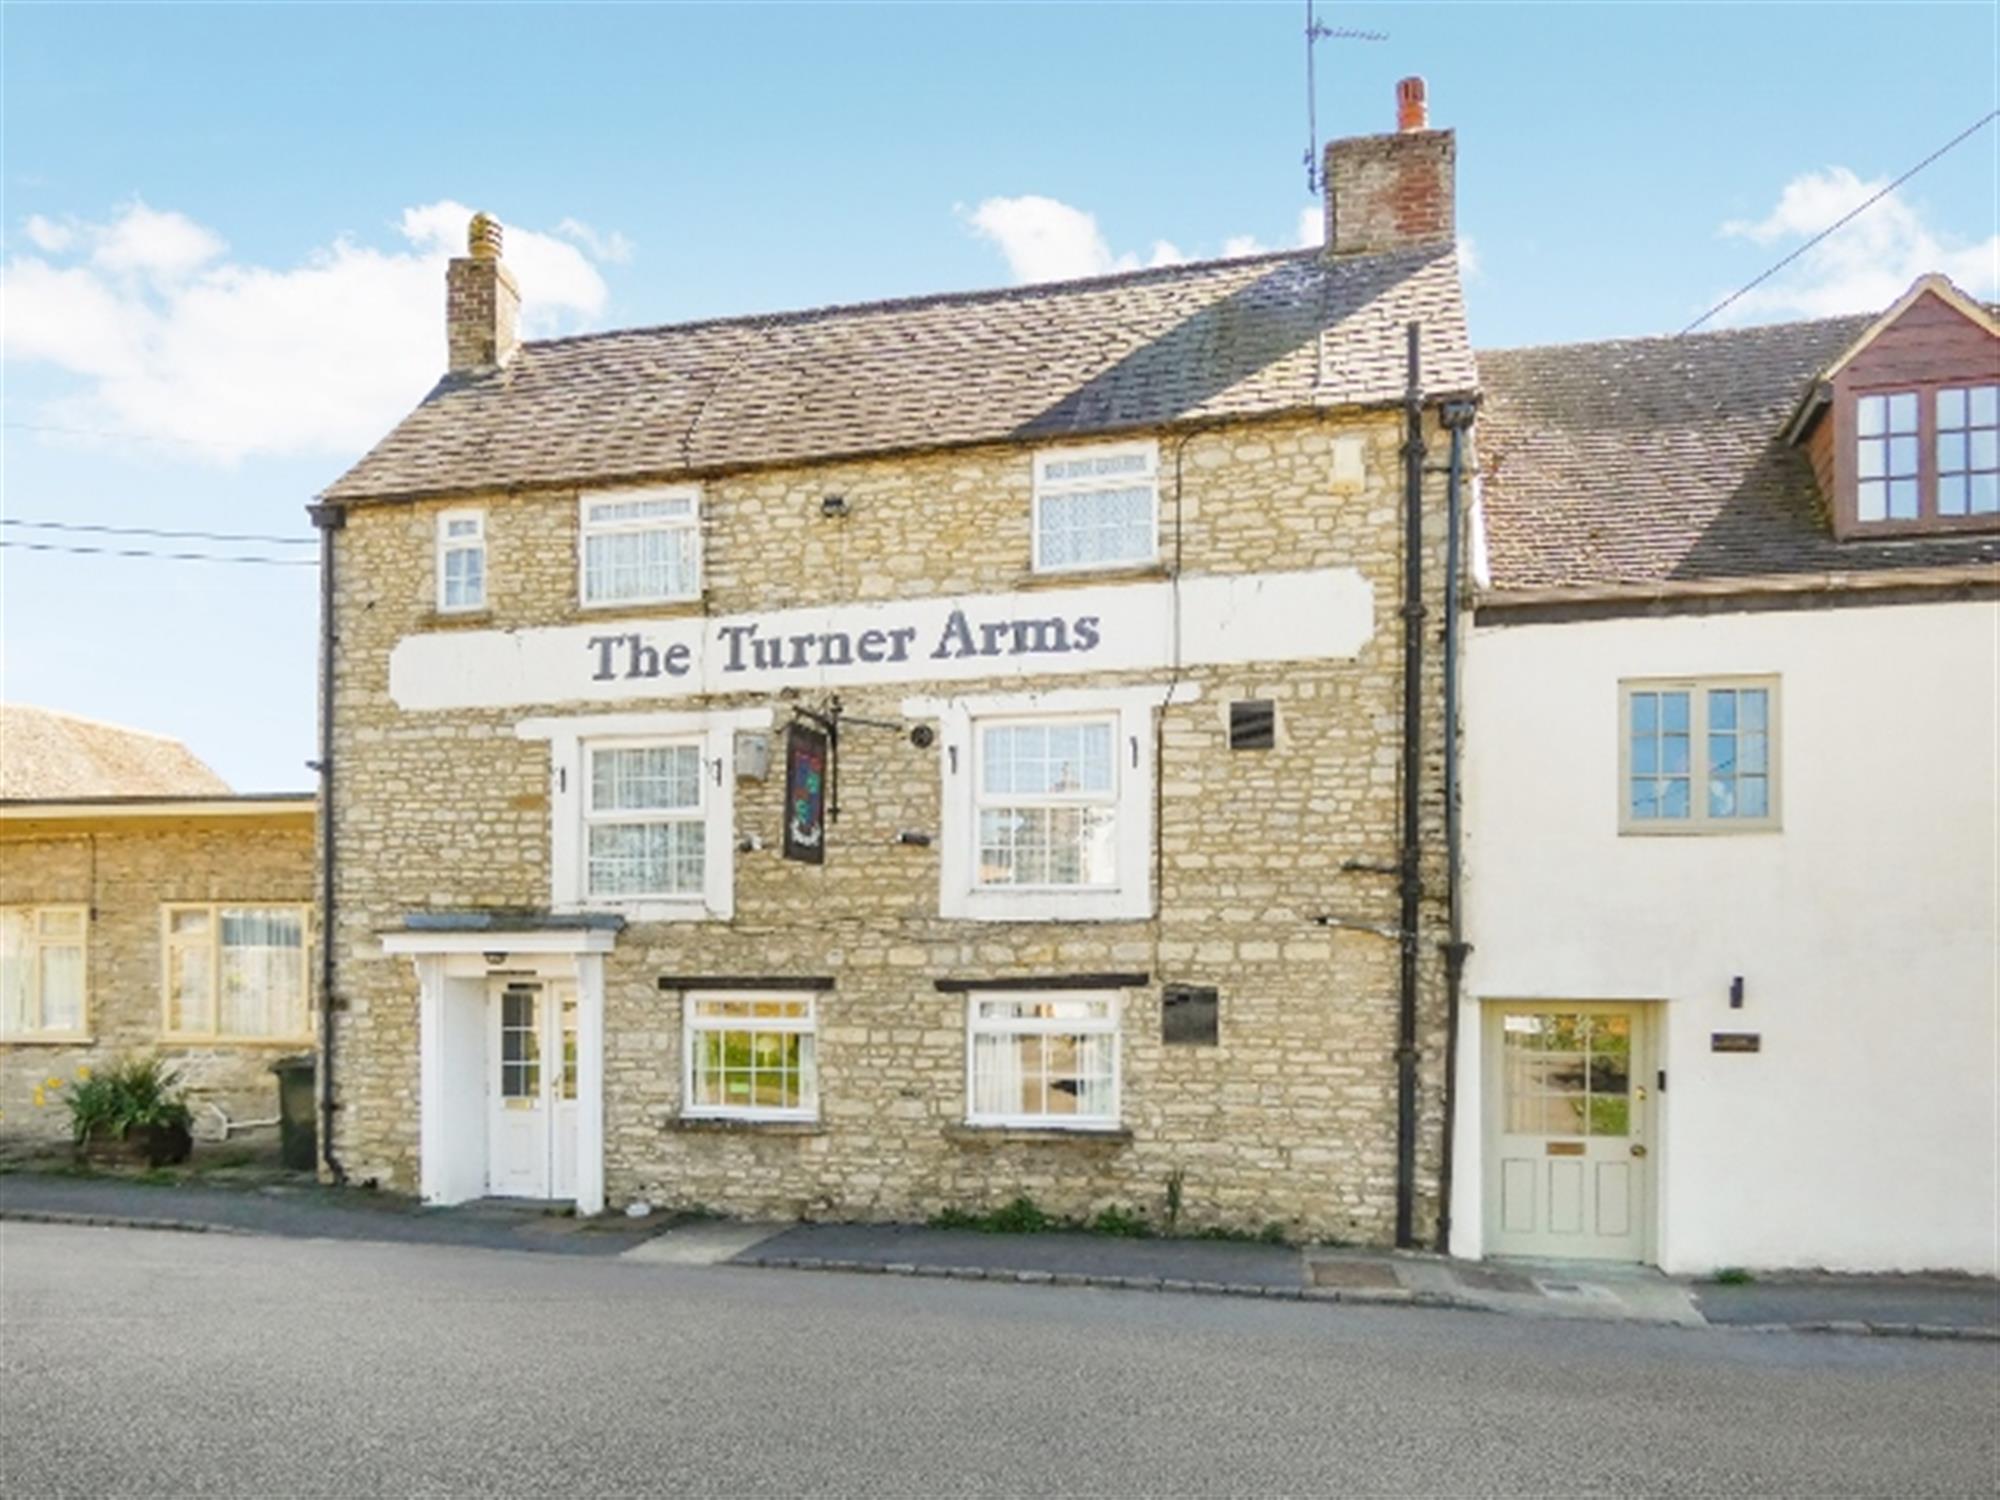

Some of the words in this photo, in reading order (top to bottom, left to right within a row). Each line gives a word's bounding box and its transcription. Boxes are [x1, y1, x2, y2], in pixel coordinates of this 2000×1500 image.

[587, 634, 690, 681] The
[717, 623, 916, 672] Turner
[930, 610, 1100, 659] Arms
